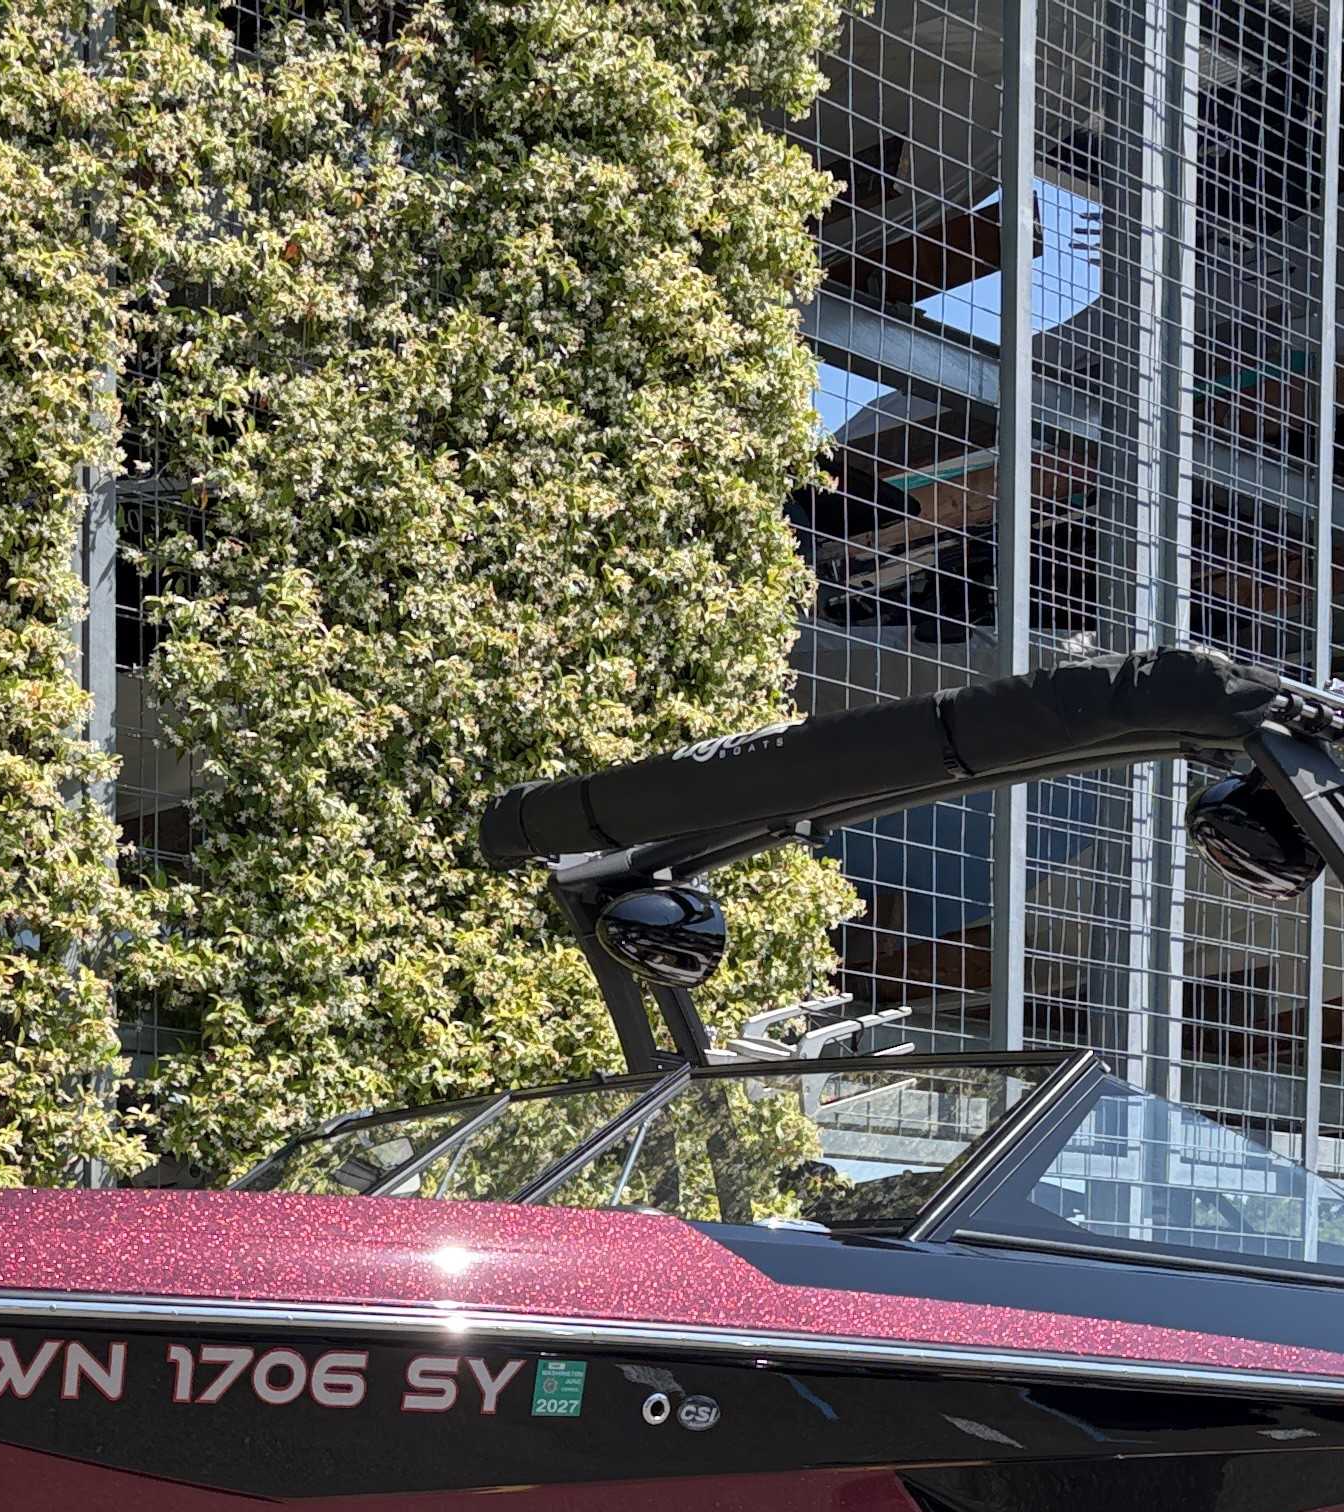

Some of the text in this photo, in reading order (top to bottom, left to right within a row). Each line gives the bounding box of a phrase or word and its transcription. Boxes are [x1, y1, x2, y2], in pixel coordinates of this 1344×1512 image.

[719, 736, 784, 759] BOATS
[166, 1343, 370, 1409] 1706
[400, 1352, 526, 1415] SY
[536, 1398, 579, 1414] 2027
